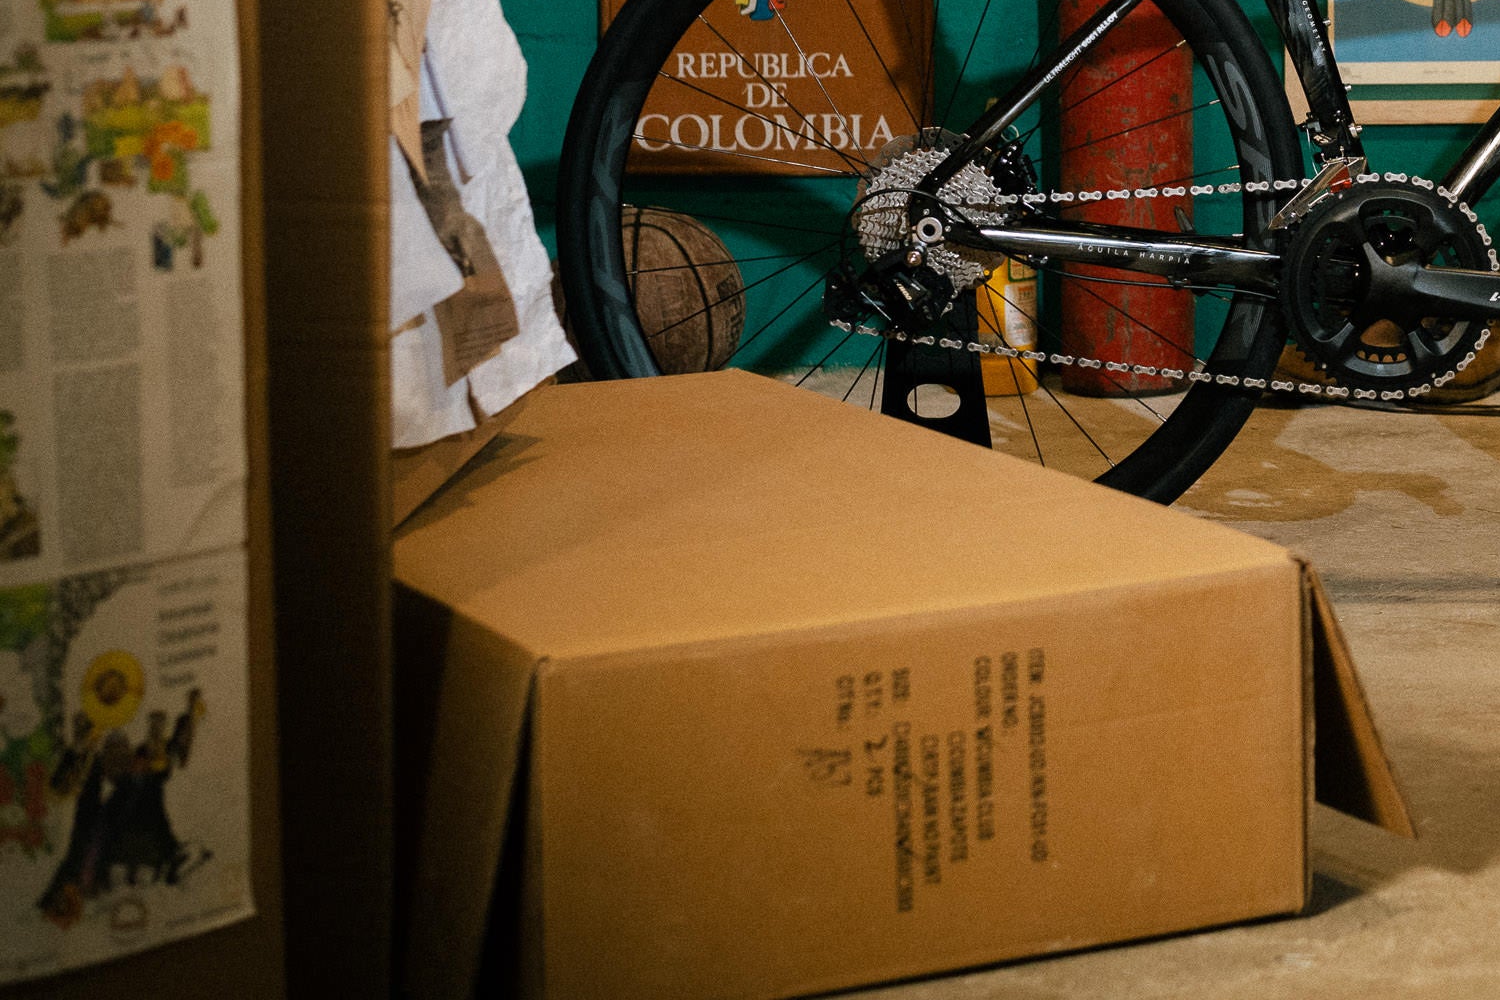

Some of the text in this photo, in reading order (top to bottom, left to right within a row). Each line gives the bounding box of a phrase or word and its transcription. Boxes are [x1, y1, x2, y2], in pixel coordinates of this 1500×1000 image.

[1302, 0, 1326, 51] GEOMETRY
[676, 52, 854, 78] REPUBLICA
[1043, 44, 1081, 83] ULTRALIGHT
[1096, 11, 1118, 34] ALLOY
[743, 82, 789, 108] DE
[632, 113, 896, 151] COLOMBIA
